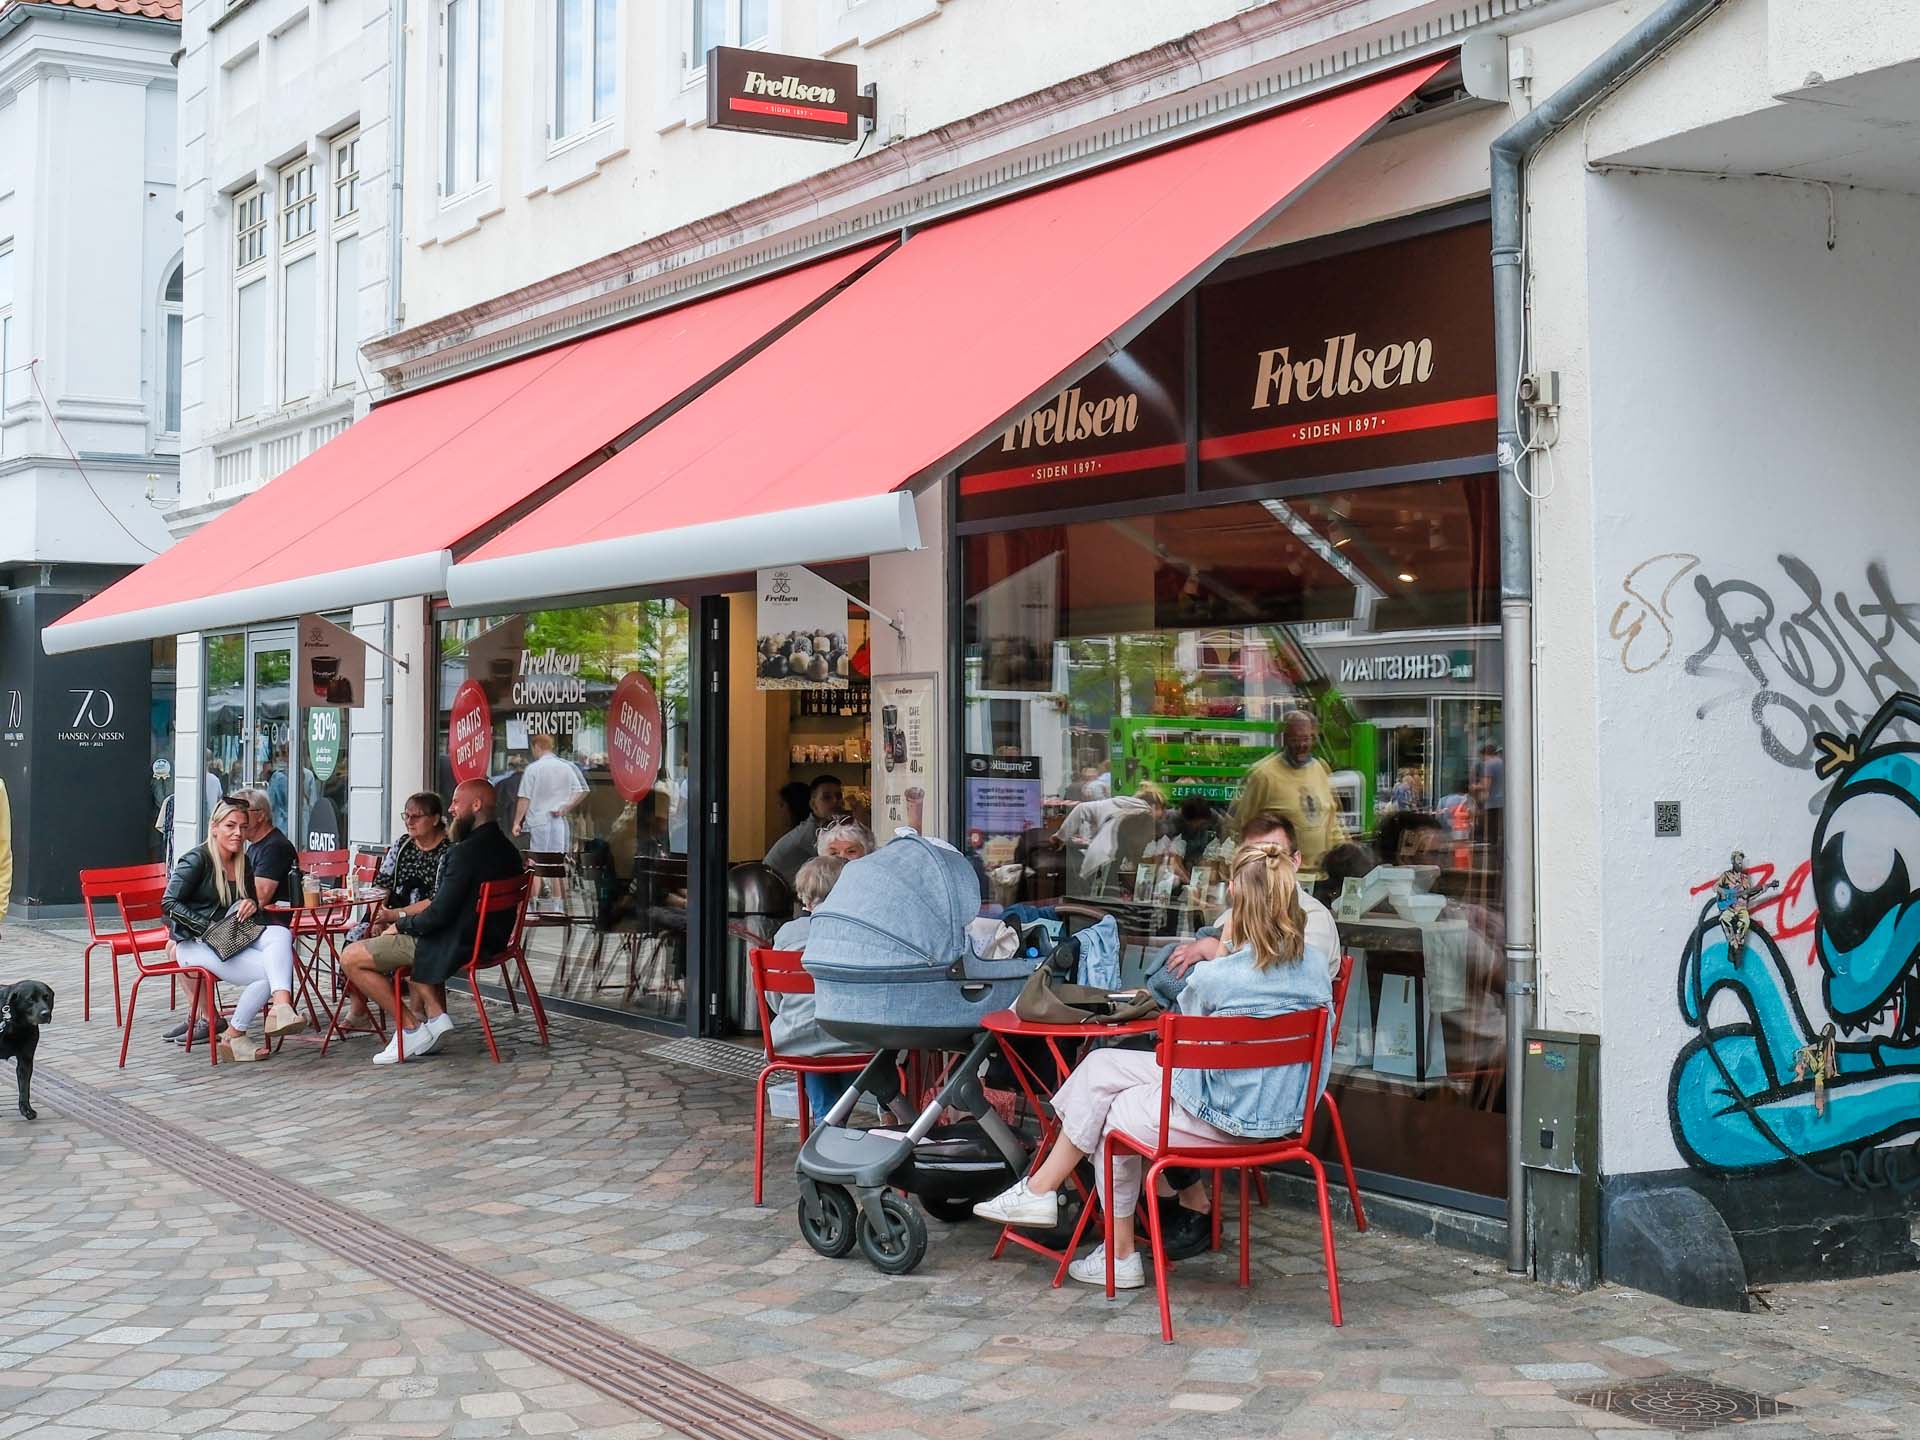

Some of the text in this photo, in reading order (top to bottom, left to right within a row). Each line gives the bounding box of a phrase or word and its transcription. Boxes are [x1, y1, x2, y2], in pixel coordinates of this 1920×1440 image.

[743, 70, 837, 104] Frellsen
[771, 105, 791, 115] SIDEN
[1251, 332, 1434, 410] Frellsen
[1299, 416, 1378, 440] SIDEN 1897
[1036, 460, 1096, 480] SIDEN 1897
[519, 648, 580, 676] Frellsen
[512, 680, 586, 705] CHOKOLADE
[69, 690, 114, 728] 70
[58, 732, 89, 741] HANSEN
[98, 732, 125, 741] NISSEN
[311, 711, 337, 742] 30%
[456, 706, 482, 742] GRATIS
[620, 701, 652, 746] GRATIS
[309, 831, 336, 852] GRATIS
